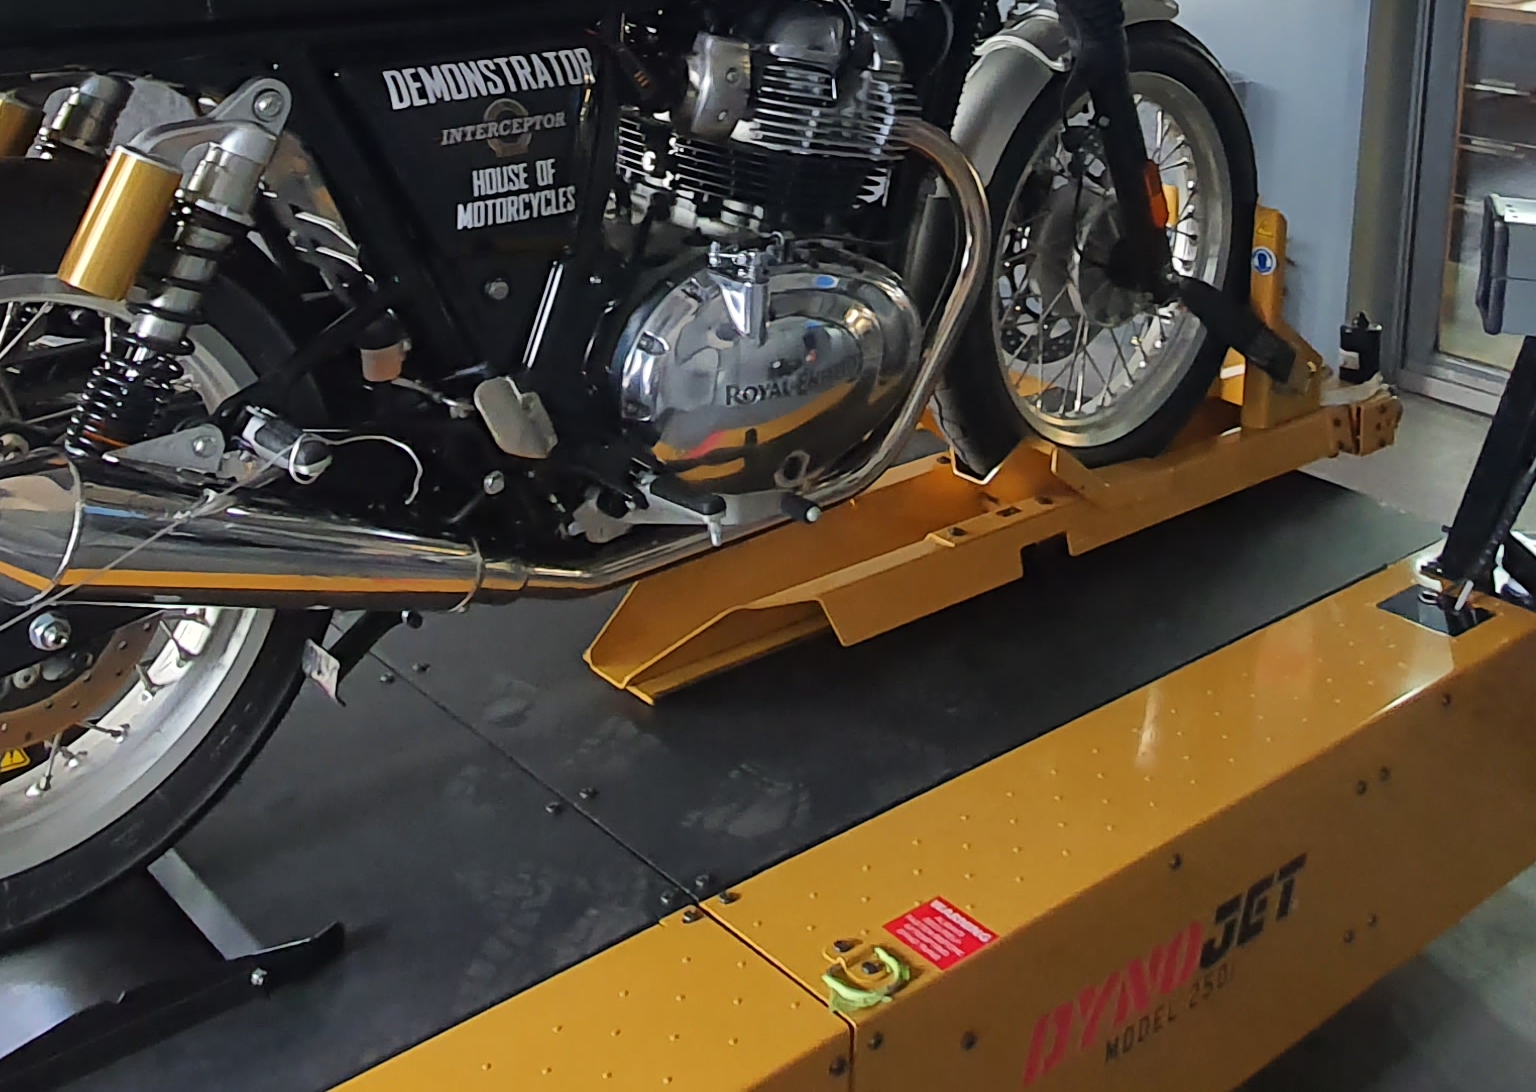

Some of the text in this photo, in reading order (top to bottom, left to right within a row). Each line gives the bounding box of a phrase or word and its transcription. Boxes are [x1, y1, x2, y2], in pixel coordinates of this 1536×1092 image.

[382, 47, 596, 110] DEMONSTRATOR
[440, 111, 567, 146] INTERCEPTOR
[472, 158, 556, 197] HOUSE OF
[456, 185, 576, 230] MOTORCYCLES
[725, 374, 791, 406] ROYAL
[1105, 1004, 1177, 1064] MODEL
